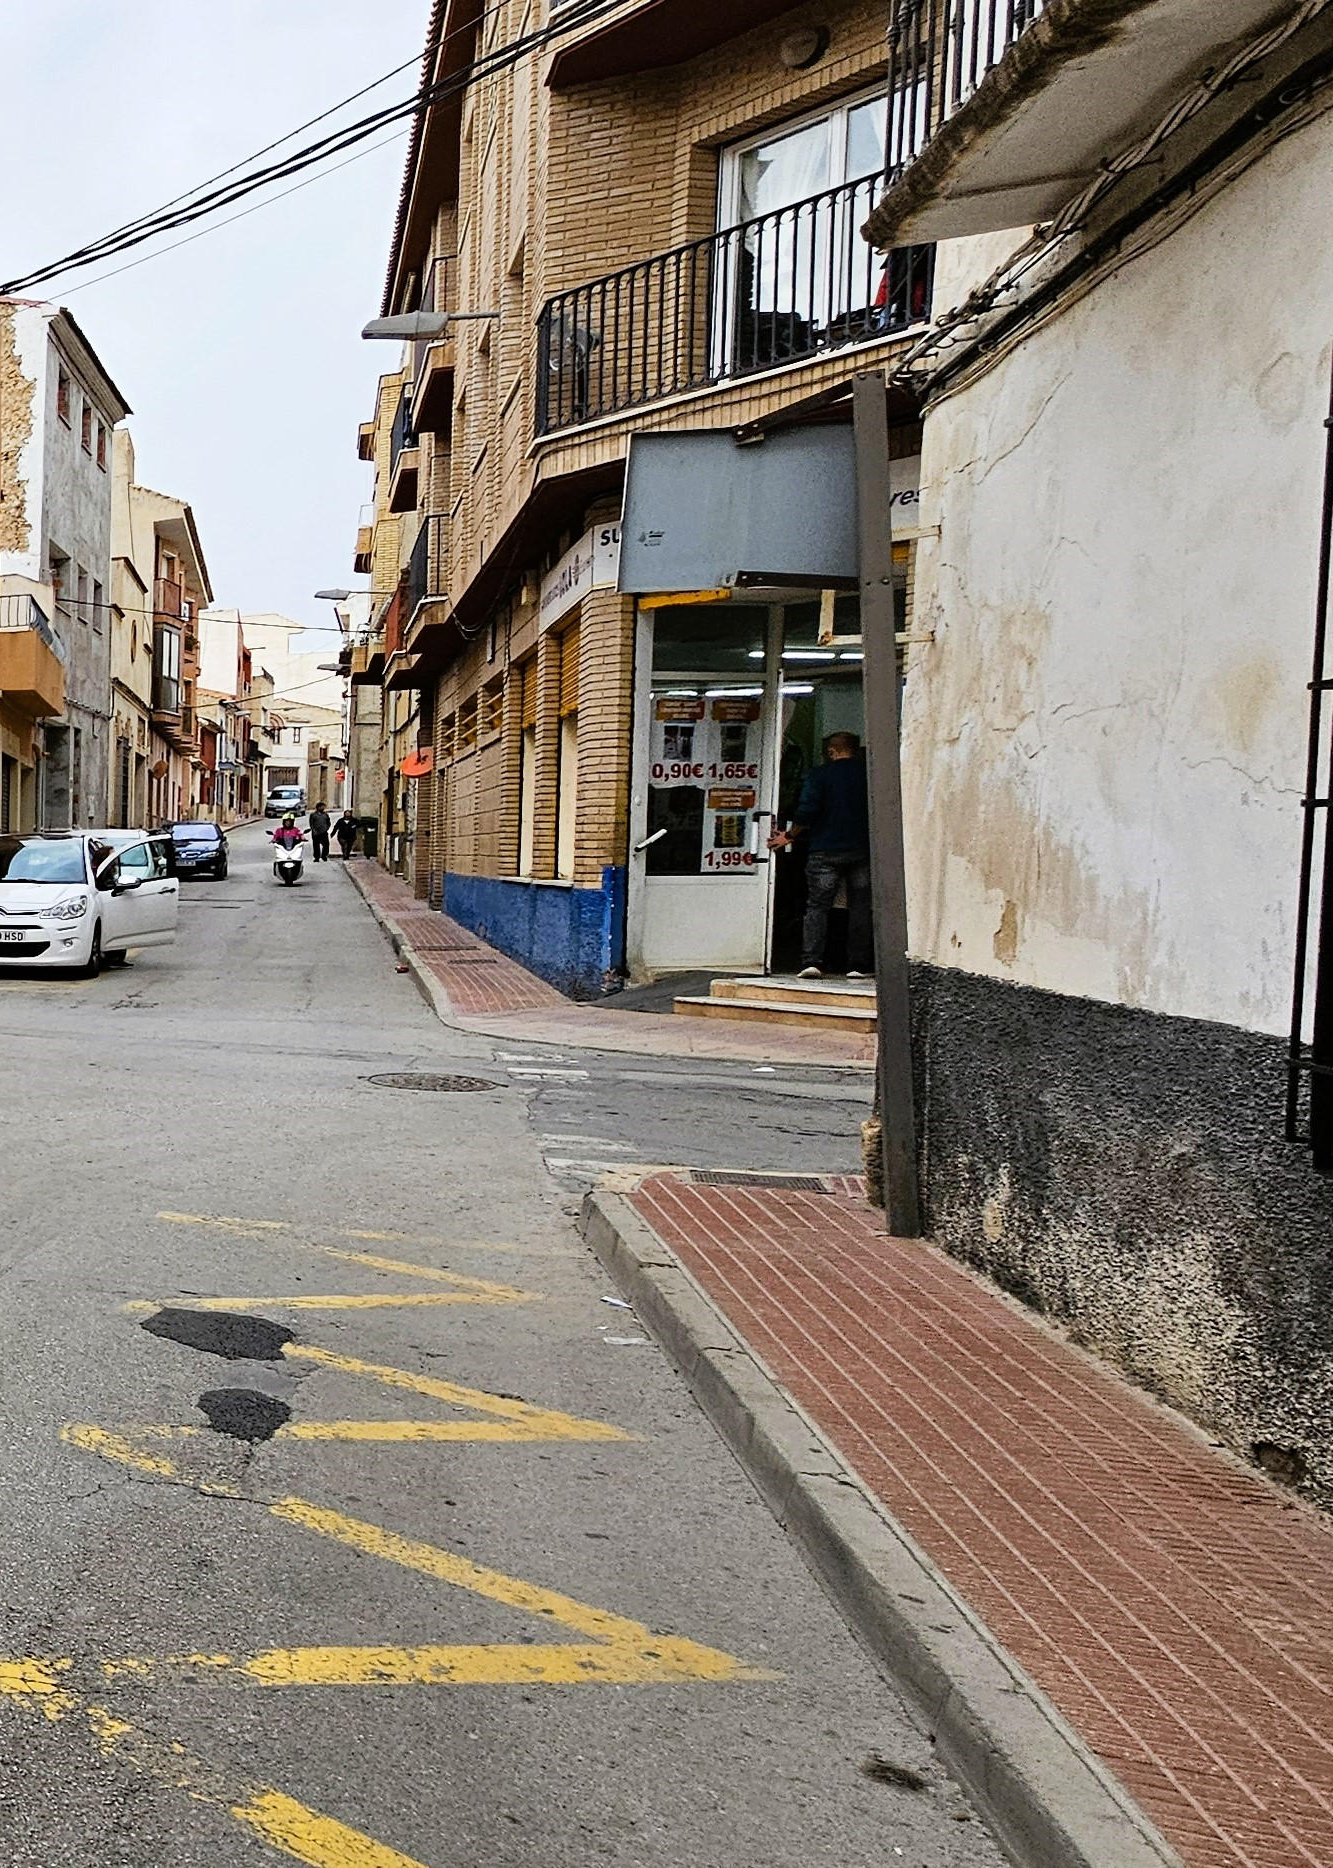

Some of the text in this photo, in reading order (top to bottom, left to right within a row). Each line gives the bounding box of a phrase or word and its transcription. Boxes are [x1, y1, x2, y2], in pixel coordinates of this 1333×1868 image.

[652, 763, 704, 781] 0,90€
[708, 763, 758, 781] 1,65€
[704, 851, 754, 869] 1,99€
[4, 931, 23, 941] HSD
